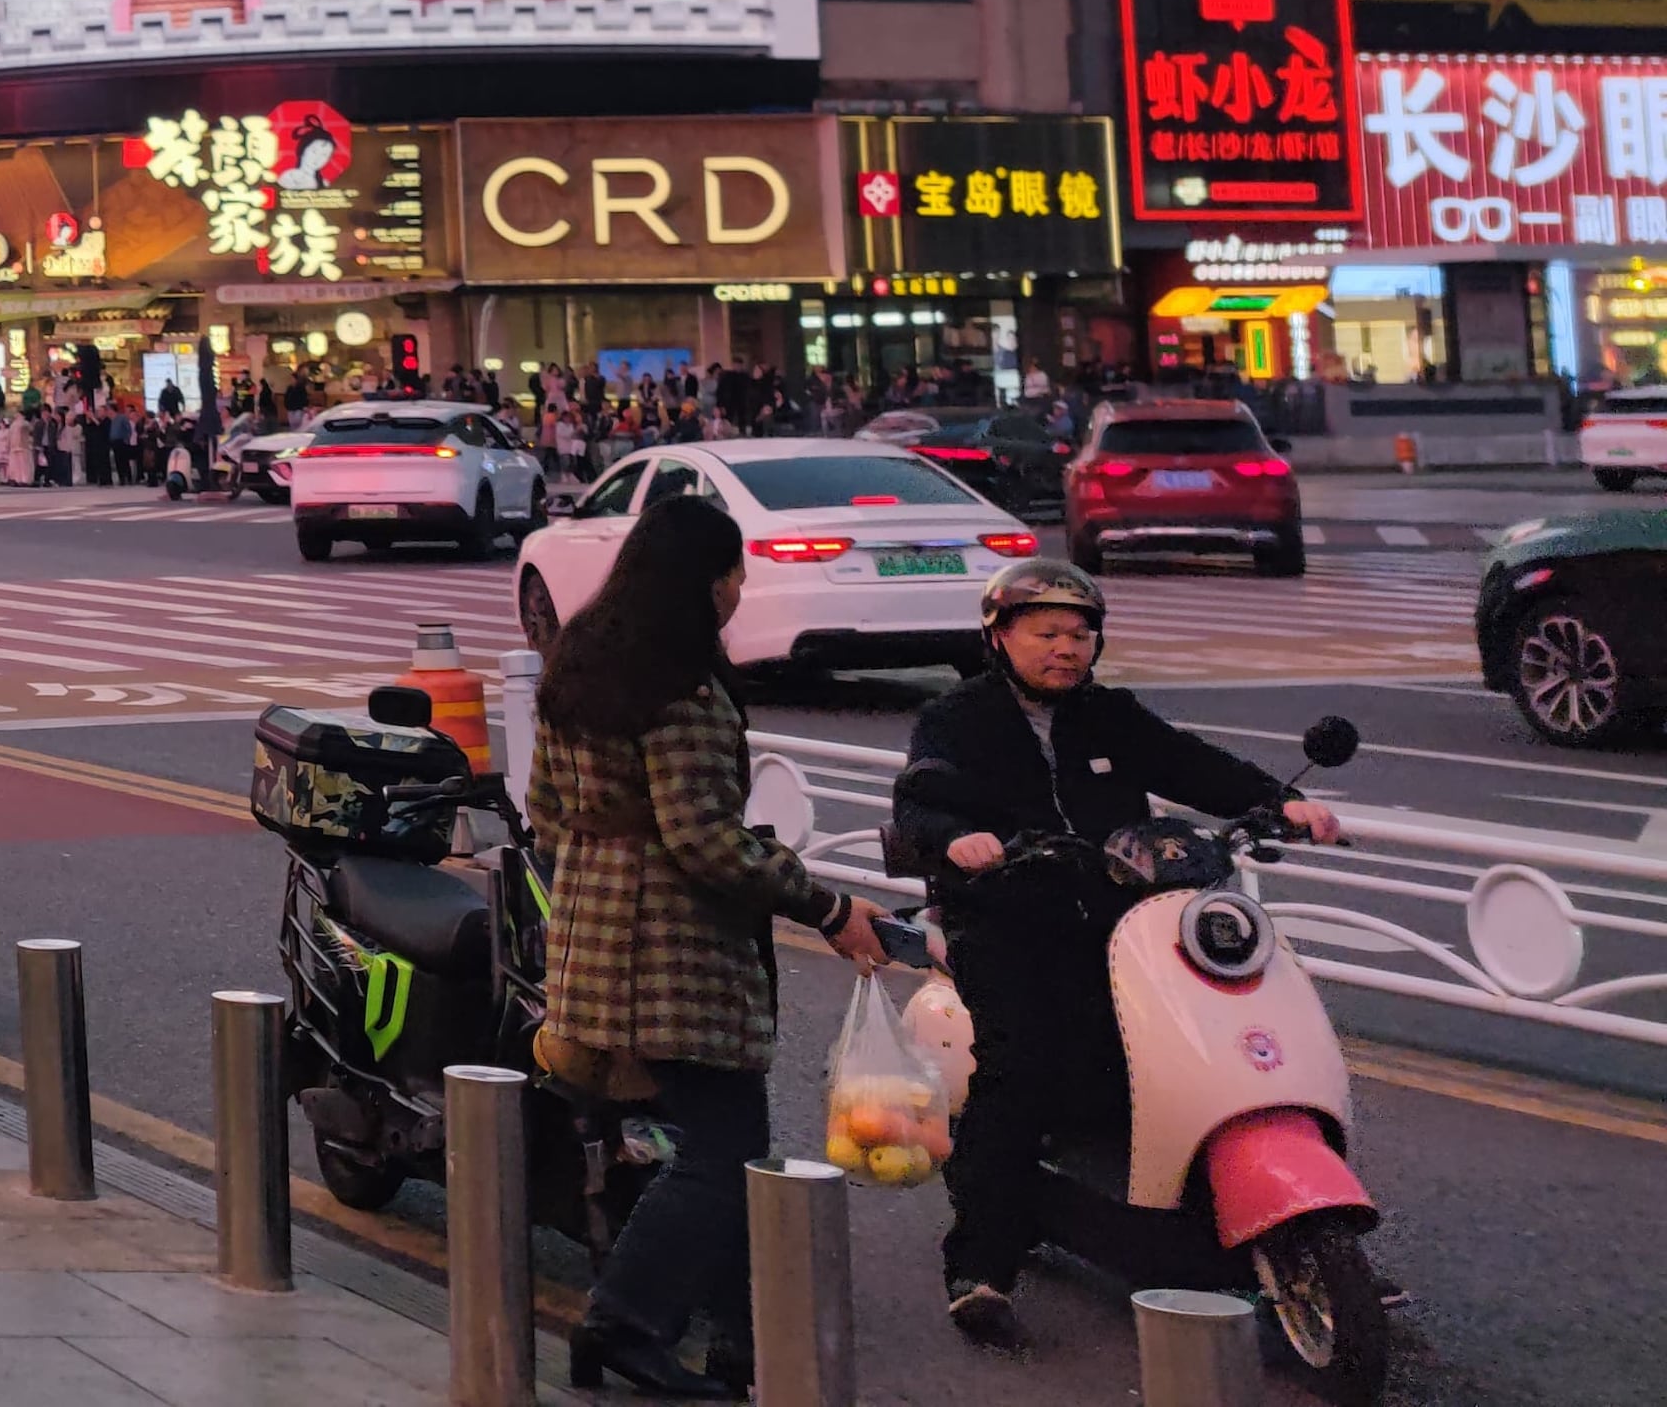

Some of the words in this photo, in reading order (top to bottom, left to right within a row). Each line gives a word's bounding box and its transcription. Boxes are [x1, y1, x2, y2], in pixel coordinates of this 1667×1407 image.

[1144, 25, 1339, 123] 虾小龙
[482, 157, 791, 246] CRD
[915, 171, 1100, 219] 宝岛眼镜
